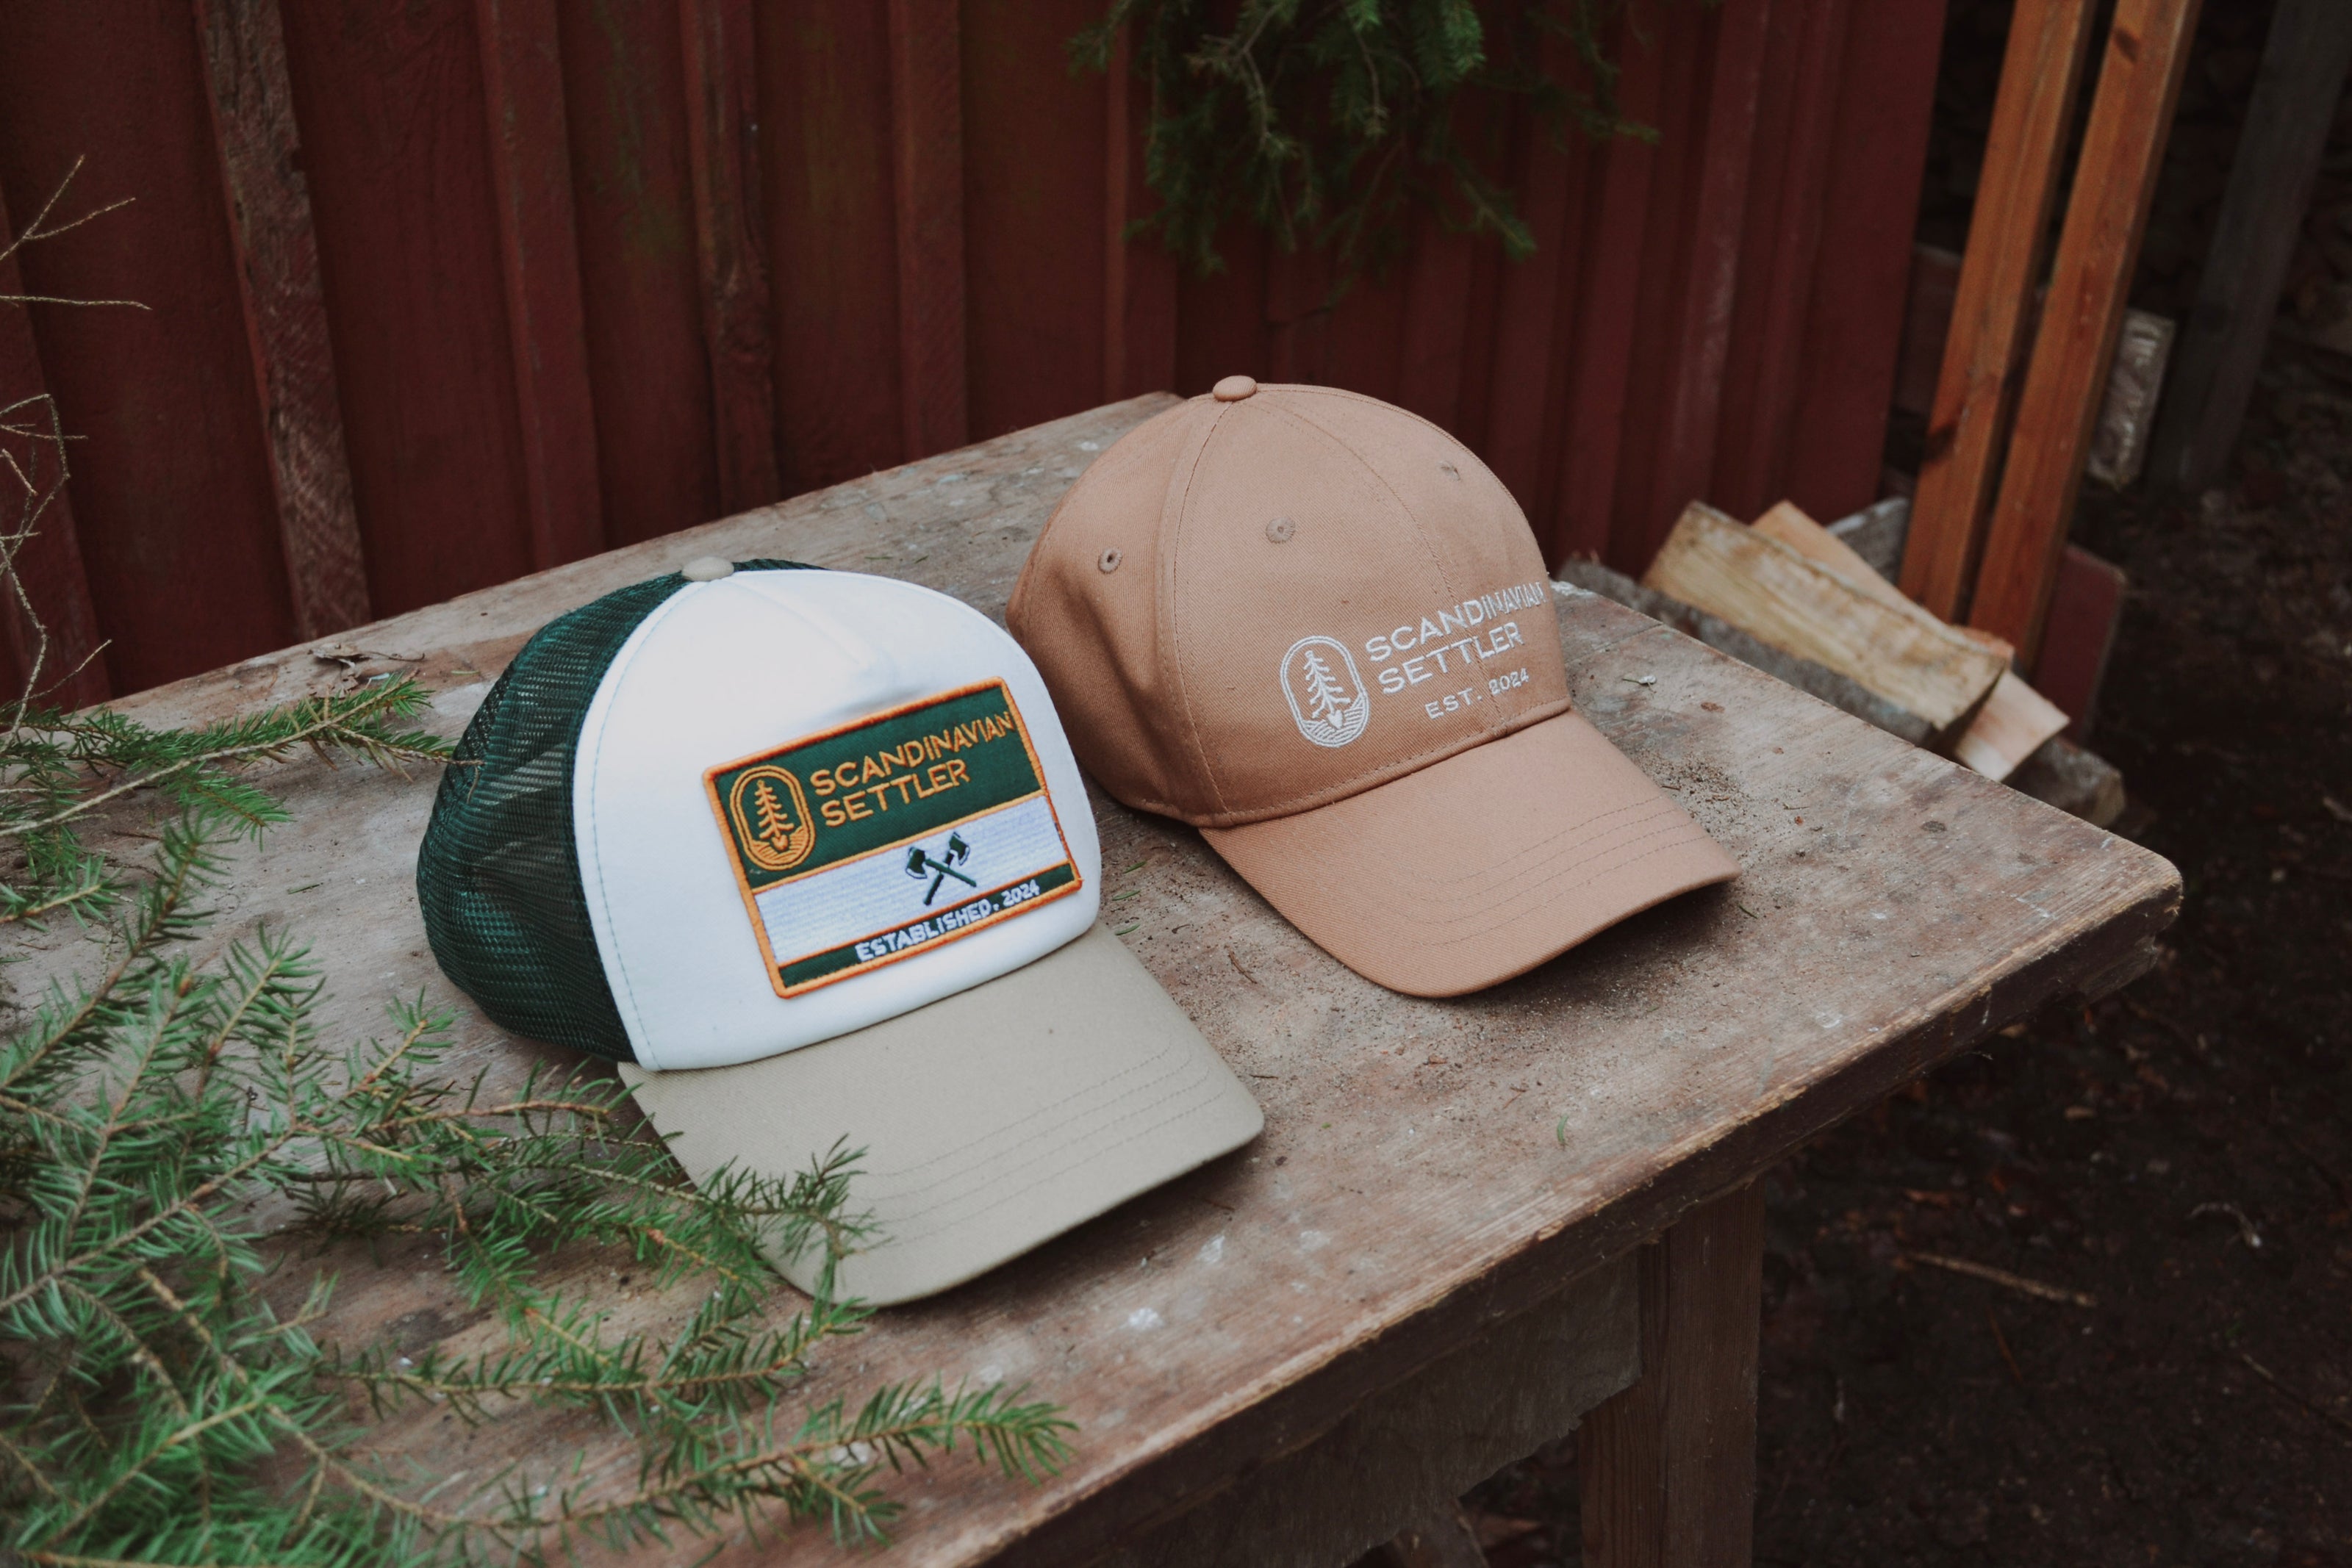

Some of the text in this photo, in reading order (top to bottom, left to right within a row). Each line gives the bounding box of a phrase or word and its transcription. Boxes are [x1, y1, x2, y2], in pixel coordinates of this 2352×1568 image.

[1366, 582, 1546, 661] SCANDINAVIAN
[1378, 622, 1524, 694] SETTLER
[1424, 668, 1530, 719] EST. 2024
[810, 711, 1014, 796] SCANDINAVIAN
[820, 759, 970, 827] SETTLER
[1001, 880, 1041, 907] 2024
